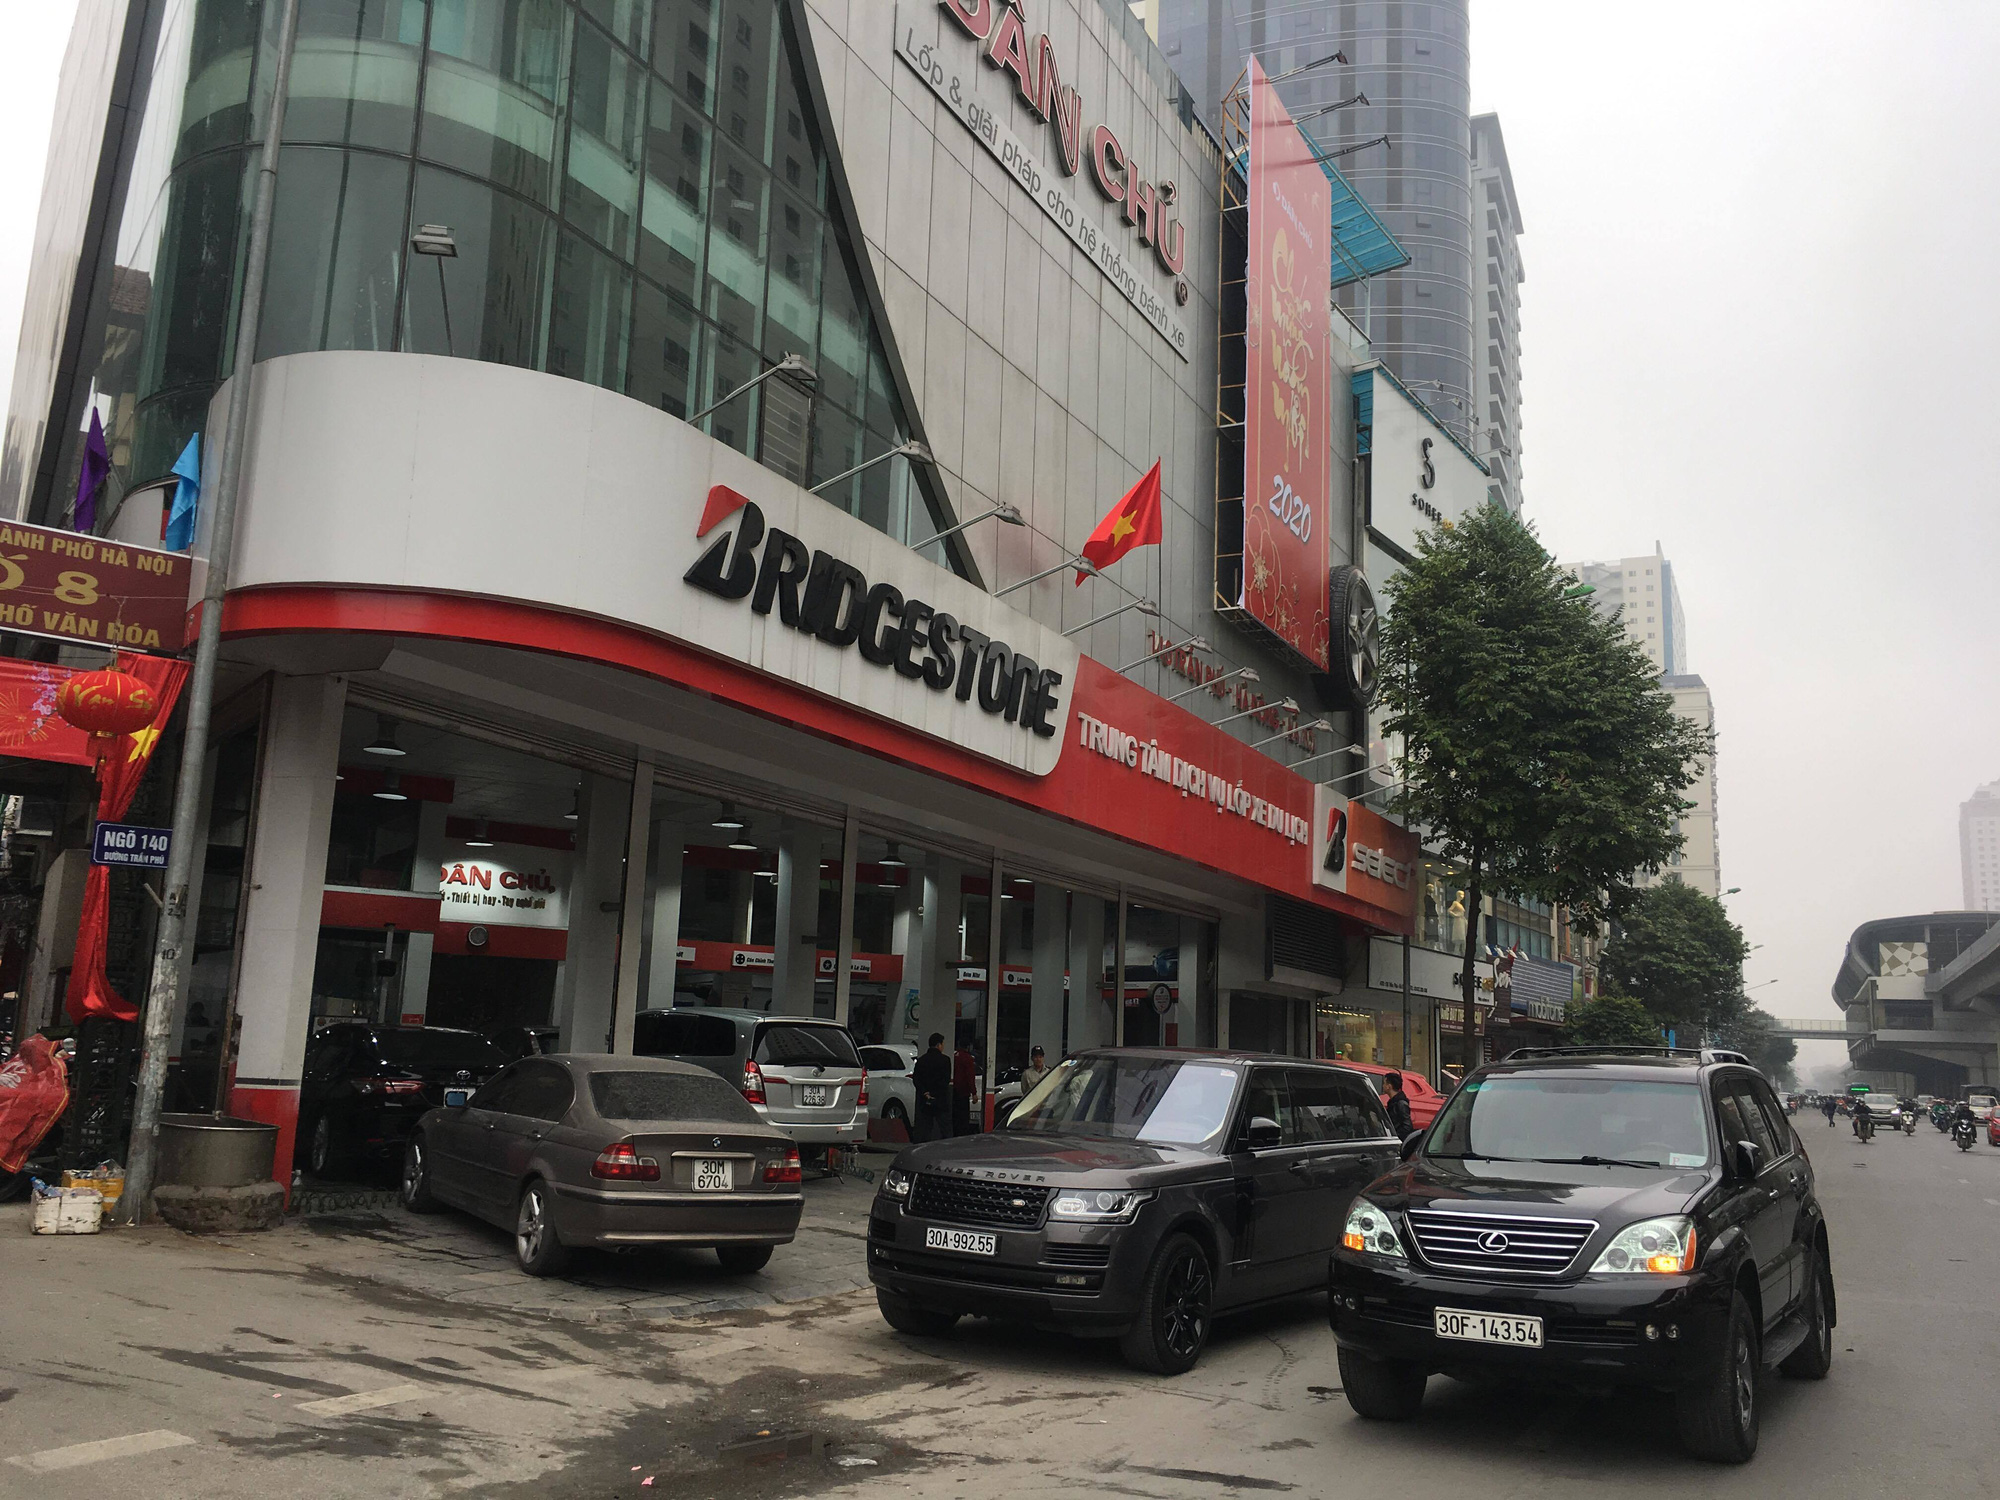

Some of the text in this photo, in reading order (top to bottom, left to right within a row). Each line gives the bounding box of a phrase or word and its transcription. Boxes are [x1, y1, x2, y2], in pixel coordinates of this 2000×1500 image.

[906, 27, 1185, 349] Lốp & giải pháp cho hệ thống bánh xe
[1088, 124, 1185, 276] CHỦ
[1269, 475, 1311, 545] 2020
[51, 536, 96, 561] PHỐ
[101, 547, 129, 567] HÀ
[136, 554, 174, 576] NỘI
[54, 570, 99, 606] 8
[683, 484, 1063, 738] BRIDGESTONE
[43, 611, 99, 638] VĂN
[106, 622, 161, 648] HÓA
[1077, 711, 1309, 846] TRUNG TÂM DỊCH VỤ LỐP XE DU LỊCH
[104, 829, 168, 852] NGÕ 140
[1453, 972, 1482, 989] SOEE
[698, 1175, 729, 1189] 6704
[702, 1160, 725, 1175] 30M
[925, 1164, 1047, 1183] RANGE ROVER
[927, 1229, 995, 1254] 30A-992.55
[1438, 1313, 1538, 1344] 30F-143.54
